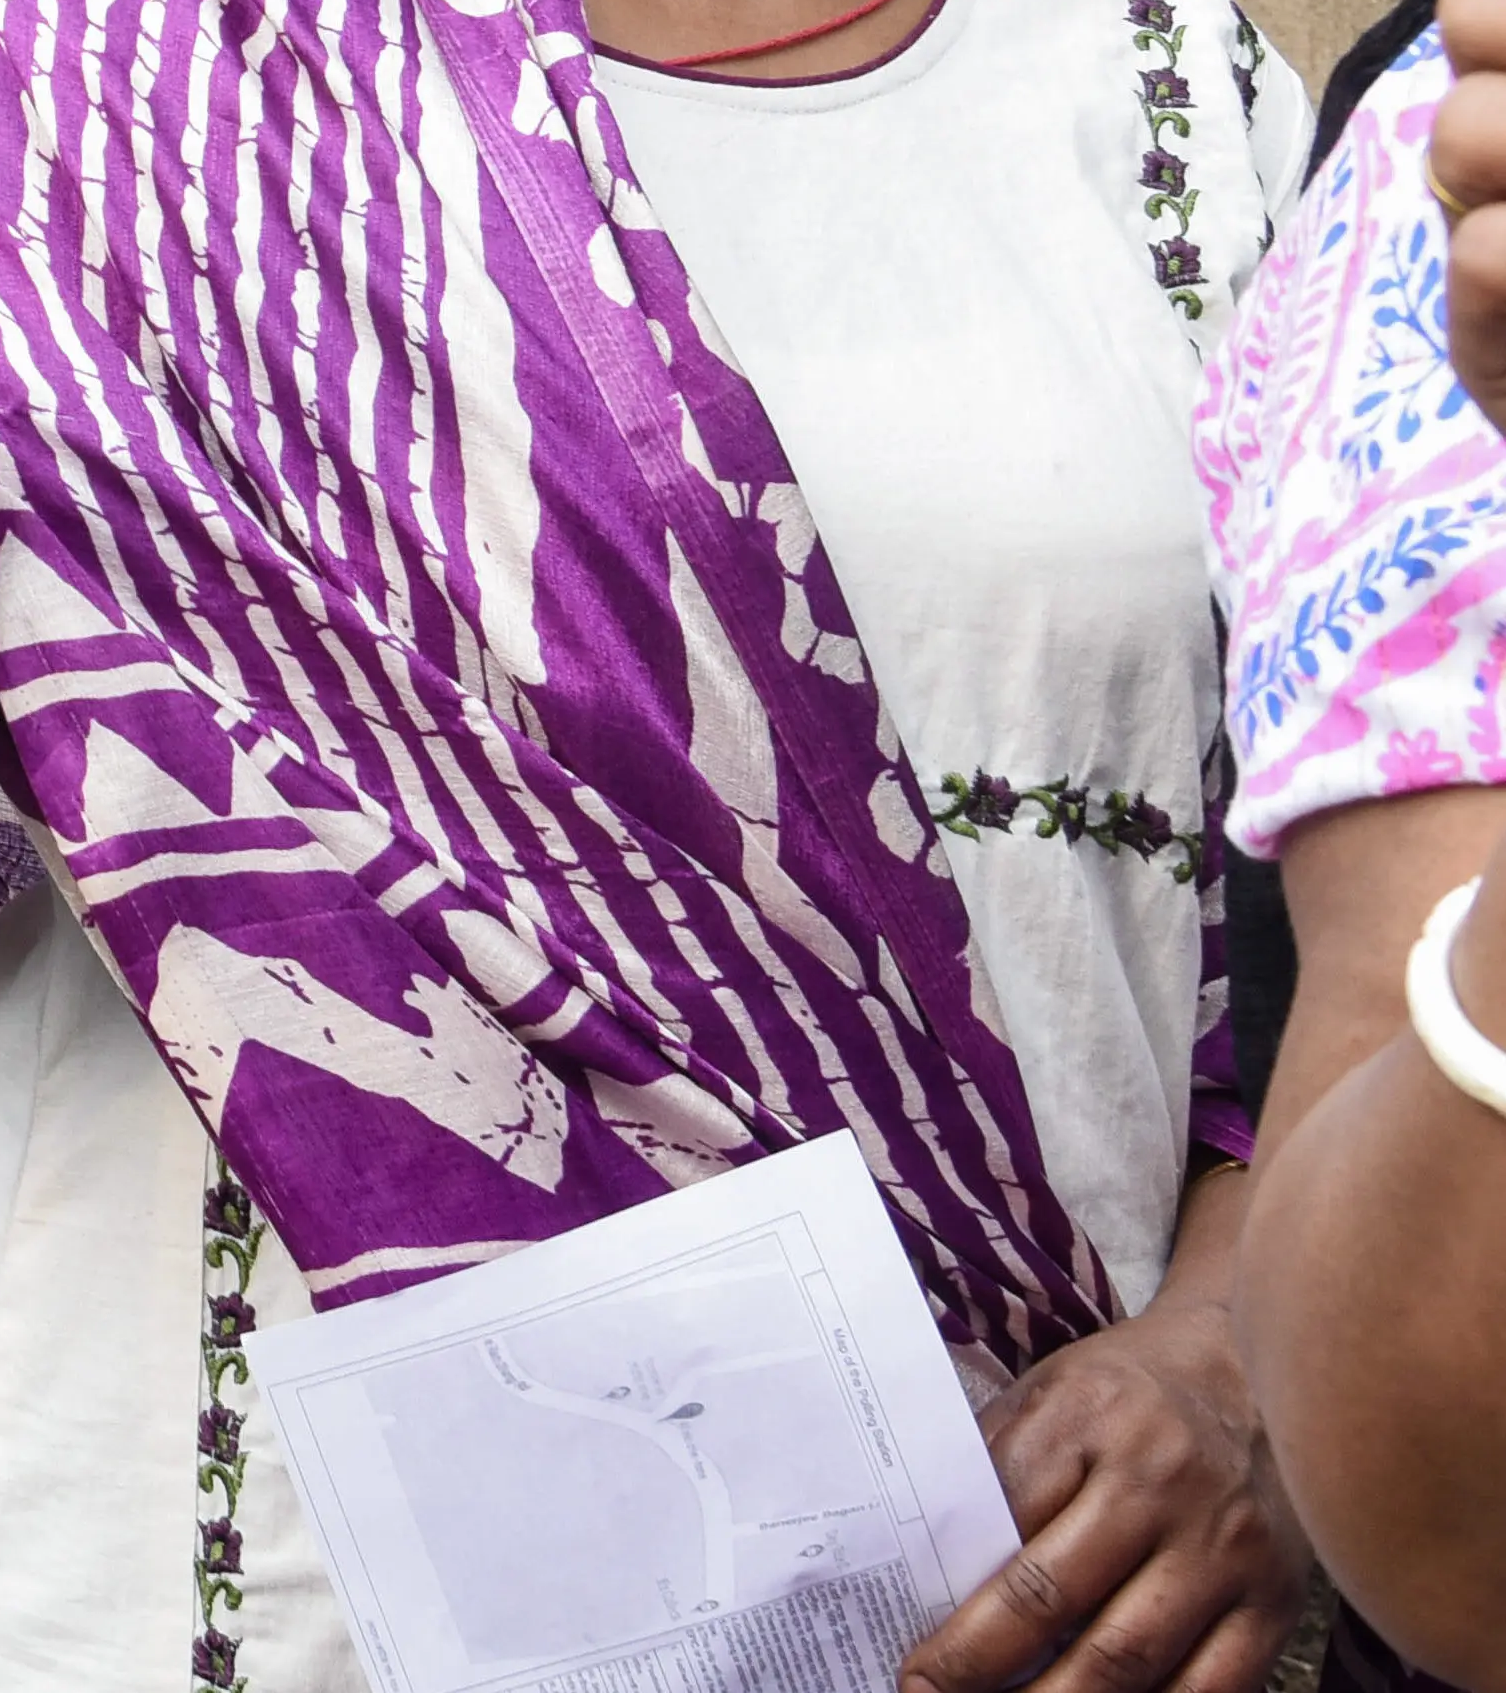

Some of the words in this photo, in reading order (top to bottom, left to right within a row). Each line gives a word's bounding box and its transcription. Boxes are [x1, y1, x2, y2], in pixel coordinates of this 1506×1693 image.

[830, 1327, 851, 1355] Map
[843, 1354, 857, 1368] of
[847, 1367, 864, 1388] the
[854, 1387, 880, 1427] Polling
[871, 1427, 896, 1468] Station
